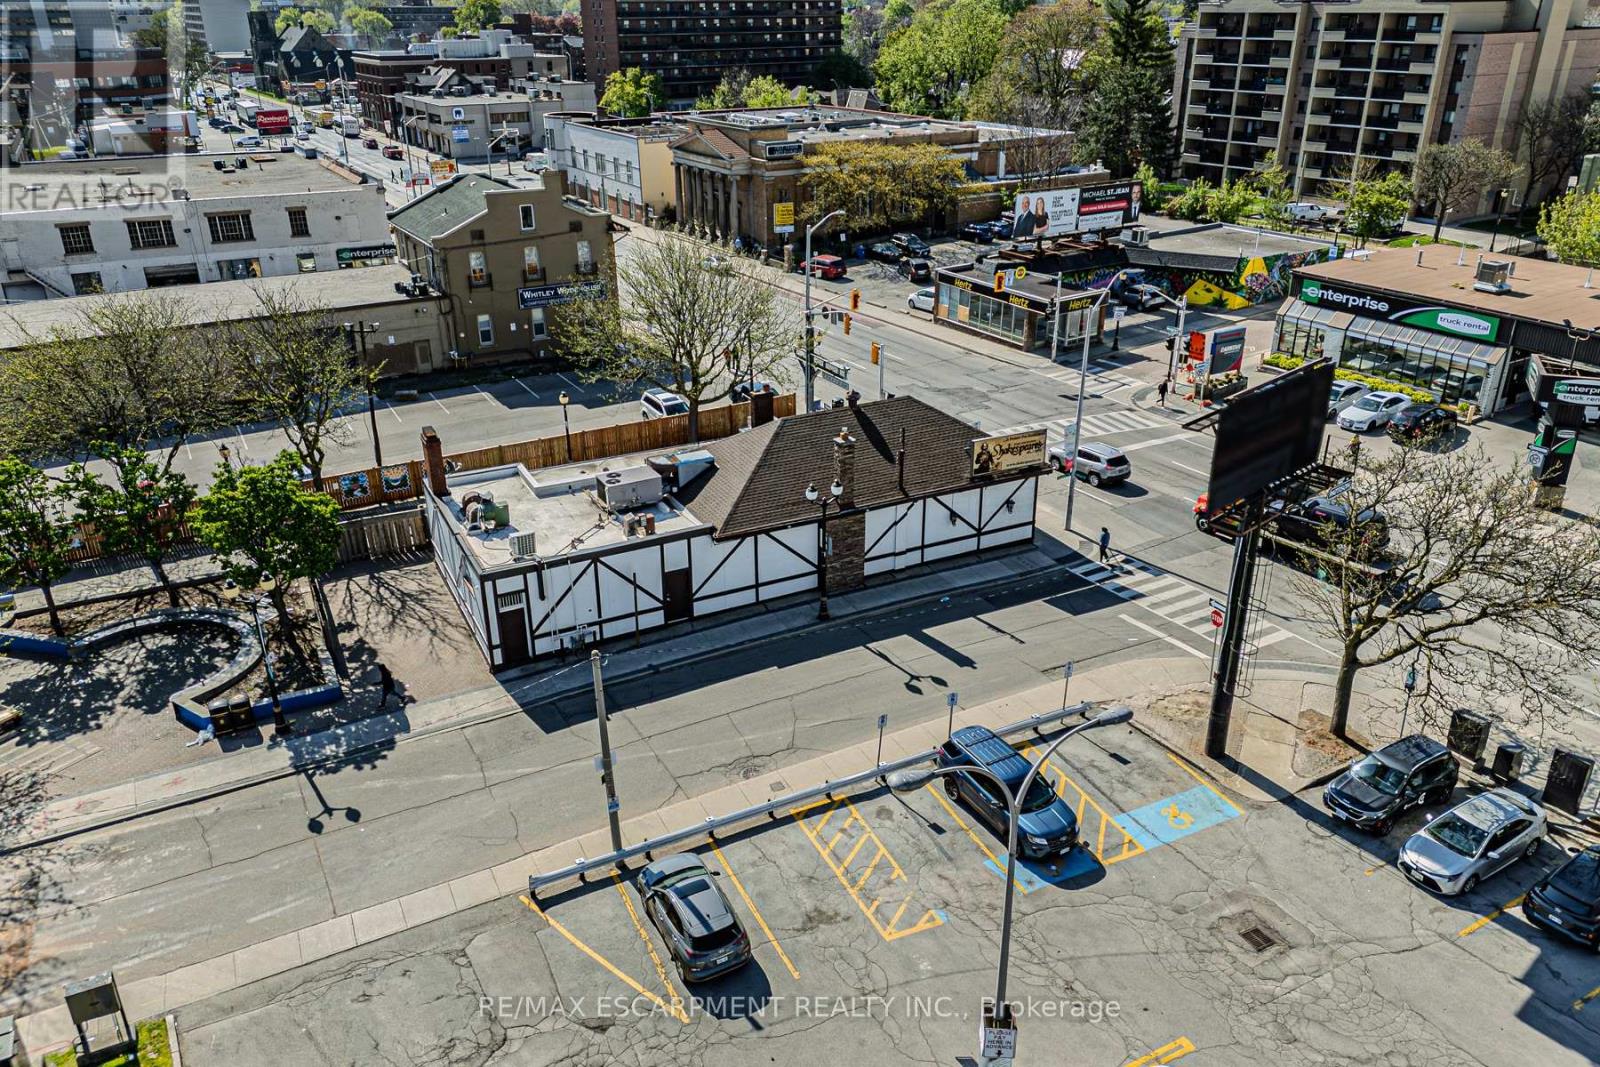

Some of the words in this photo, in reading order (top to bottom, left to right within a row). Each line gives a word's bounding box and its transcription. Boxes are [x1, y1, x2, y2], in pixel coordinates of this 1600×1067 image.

[338, 247, 397, 259] enterprise
[954, 277, 973, 291] Hertz
[1008, 294, 1030, 309] Hertz
[1068, 298, 1092, 311] Hertz
[1302, 286, 1389, 312] enterprise
[1439, 316, 1461, 326] truck
[1463, 321, 1490, 331] rental
